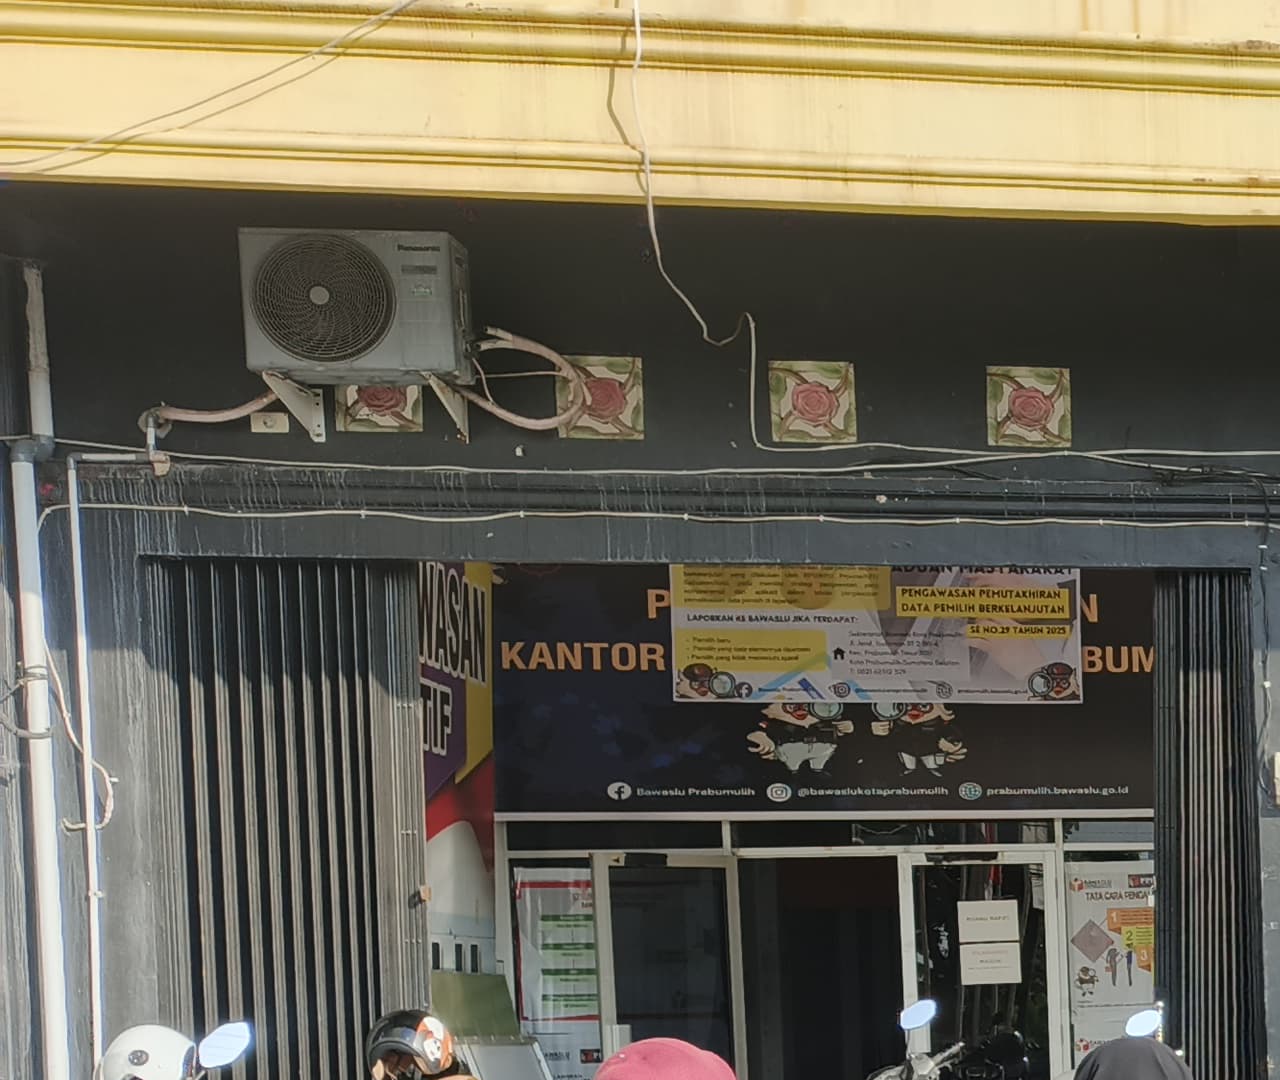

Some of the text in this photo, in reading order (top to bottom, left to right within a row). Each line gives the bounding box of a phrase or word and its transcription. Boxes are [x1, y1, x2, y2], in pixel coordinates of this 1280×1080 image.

[901, 588, 1061, 600] PENGAWASAN PEMUTAKHIRAN
[901, 603, 1065, 615] DATA PEMILIH BERKELANJUTAN
[748, 614, 791, 624] BAWASLU
[969, 626, 981, 634] SE
[1012, 626, 1044, 635] TAHUN
[1046, 626, 1067, 635] 2025
[501, 641, 667, 672] KANTOR
[636, 787, 756, 797] Bawaslu Prabumulih
[1125, 930, 1134, 942] 2
